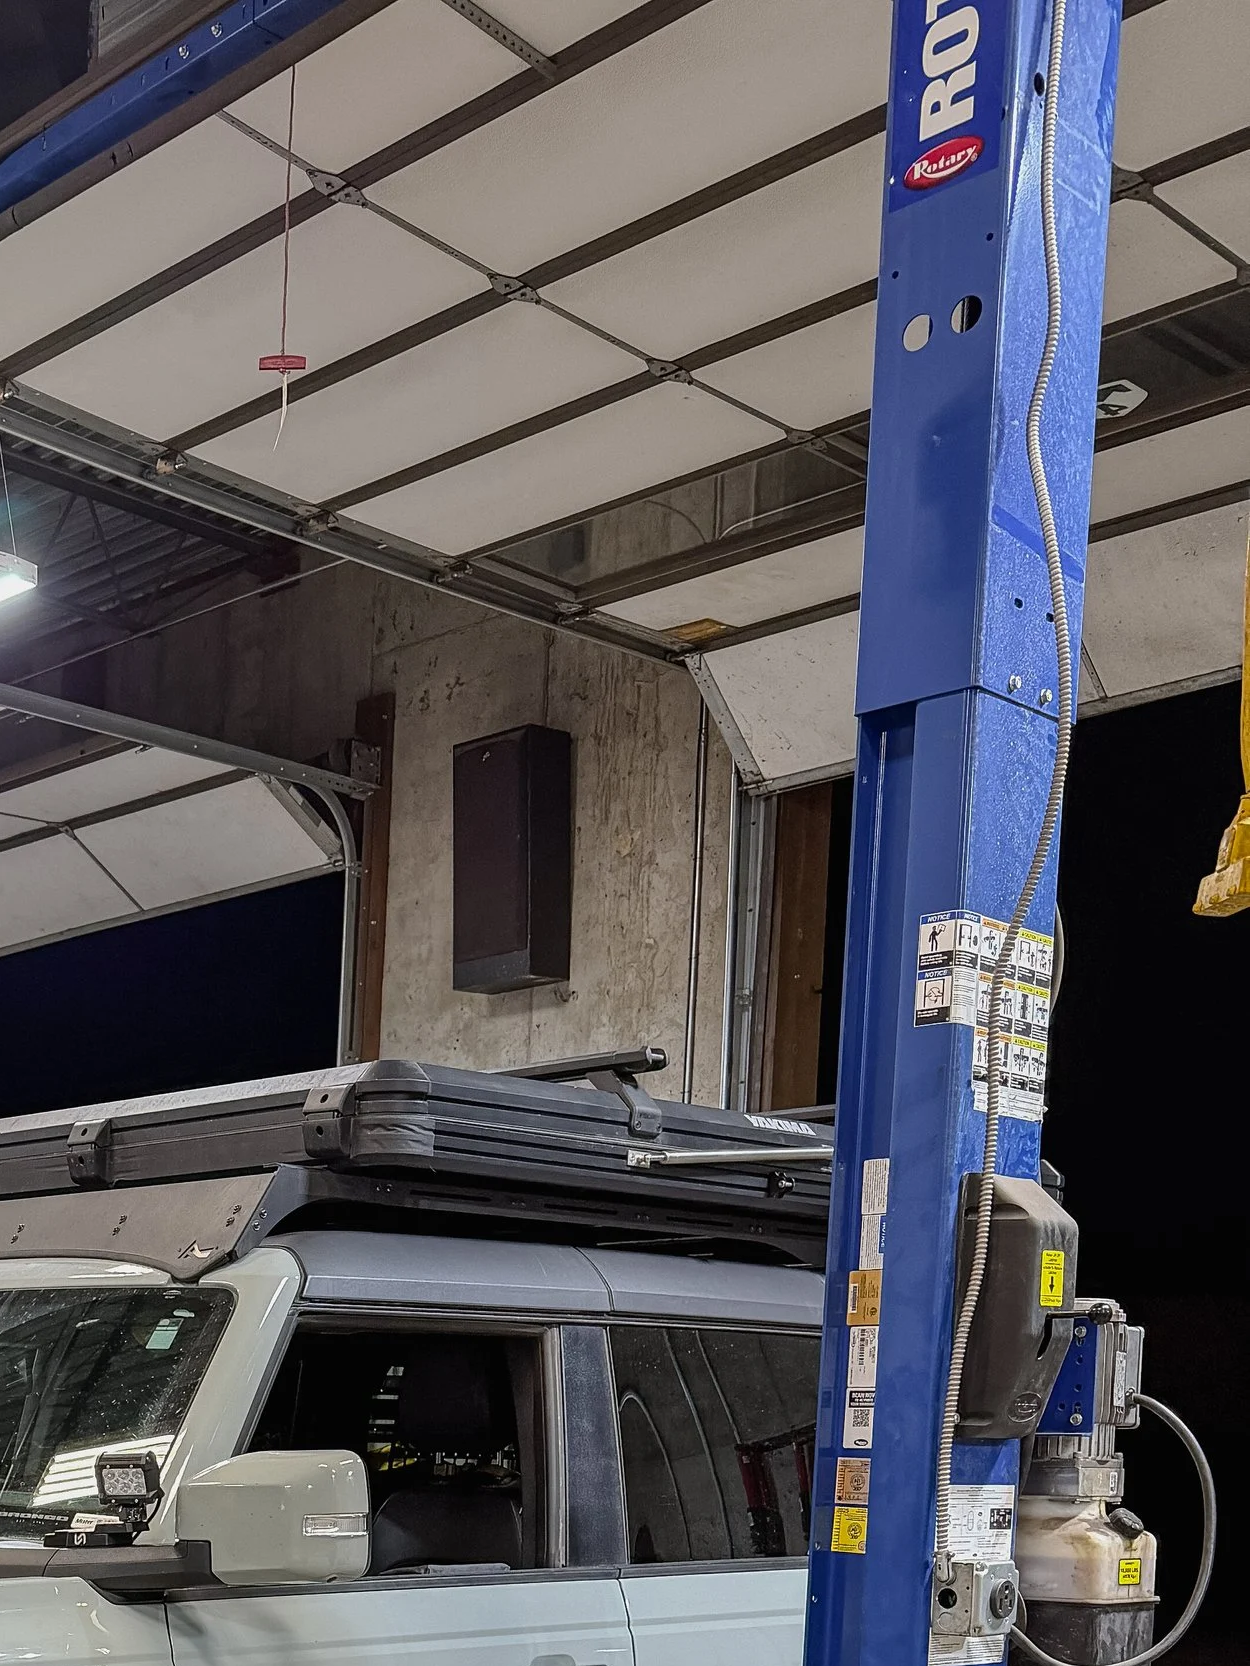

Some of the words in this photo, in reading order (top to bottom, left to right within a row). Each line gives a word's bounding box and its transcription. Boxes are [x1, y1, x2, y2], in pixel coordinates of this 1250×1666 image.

[913, 145, 978, 180] Rotary
[928, 914, 951, 922] NOTICE
[924, 970, 948, 979] NOTICE
[744, 1114, 817, 1136] YAKIMA
